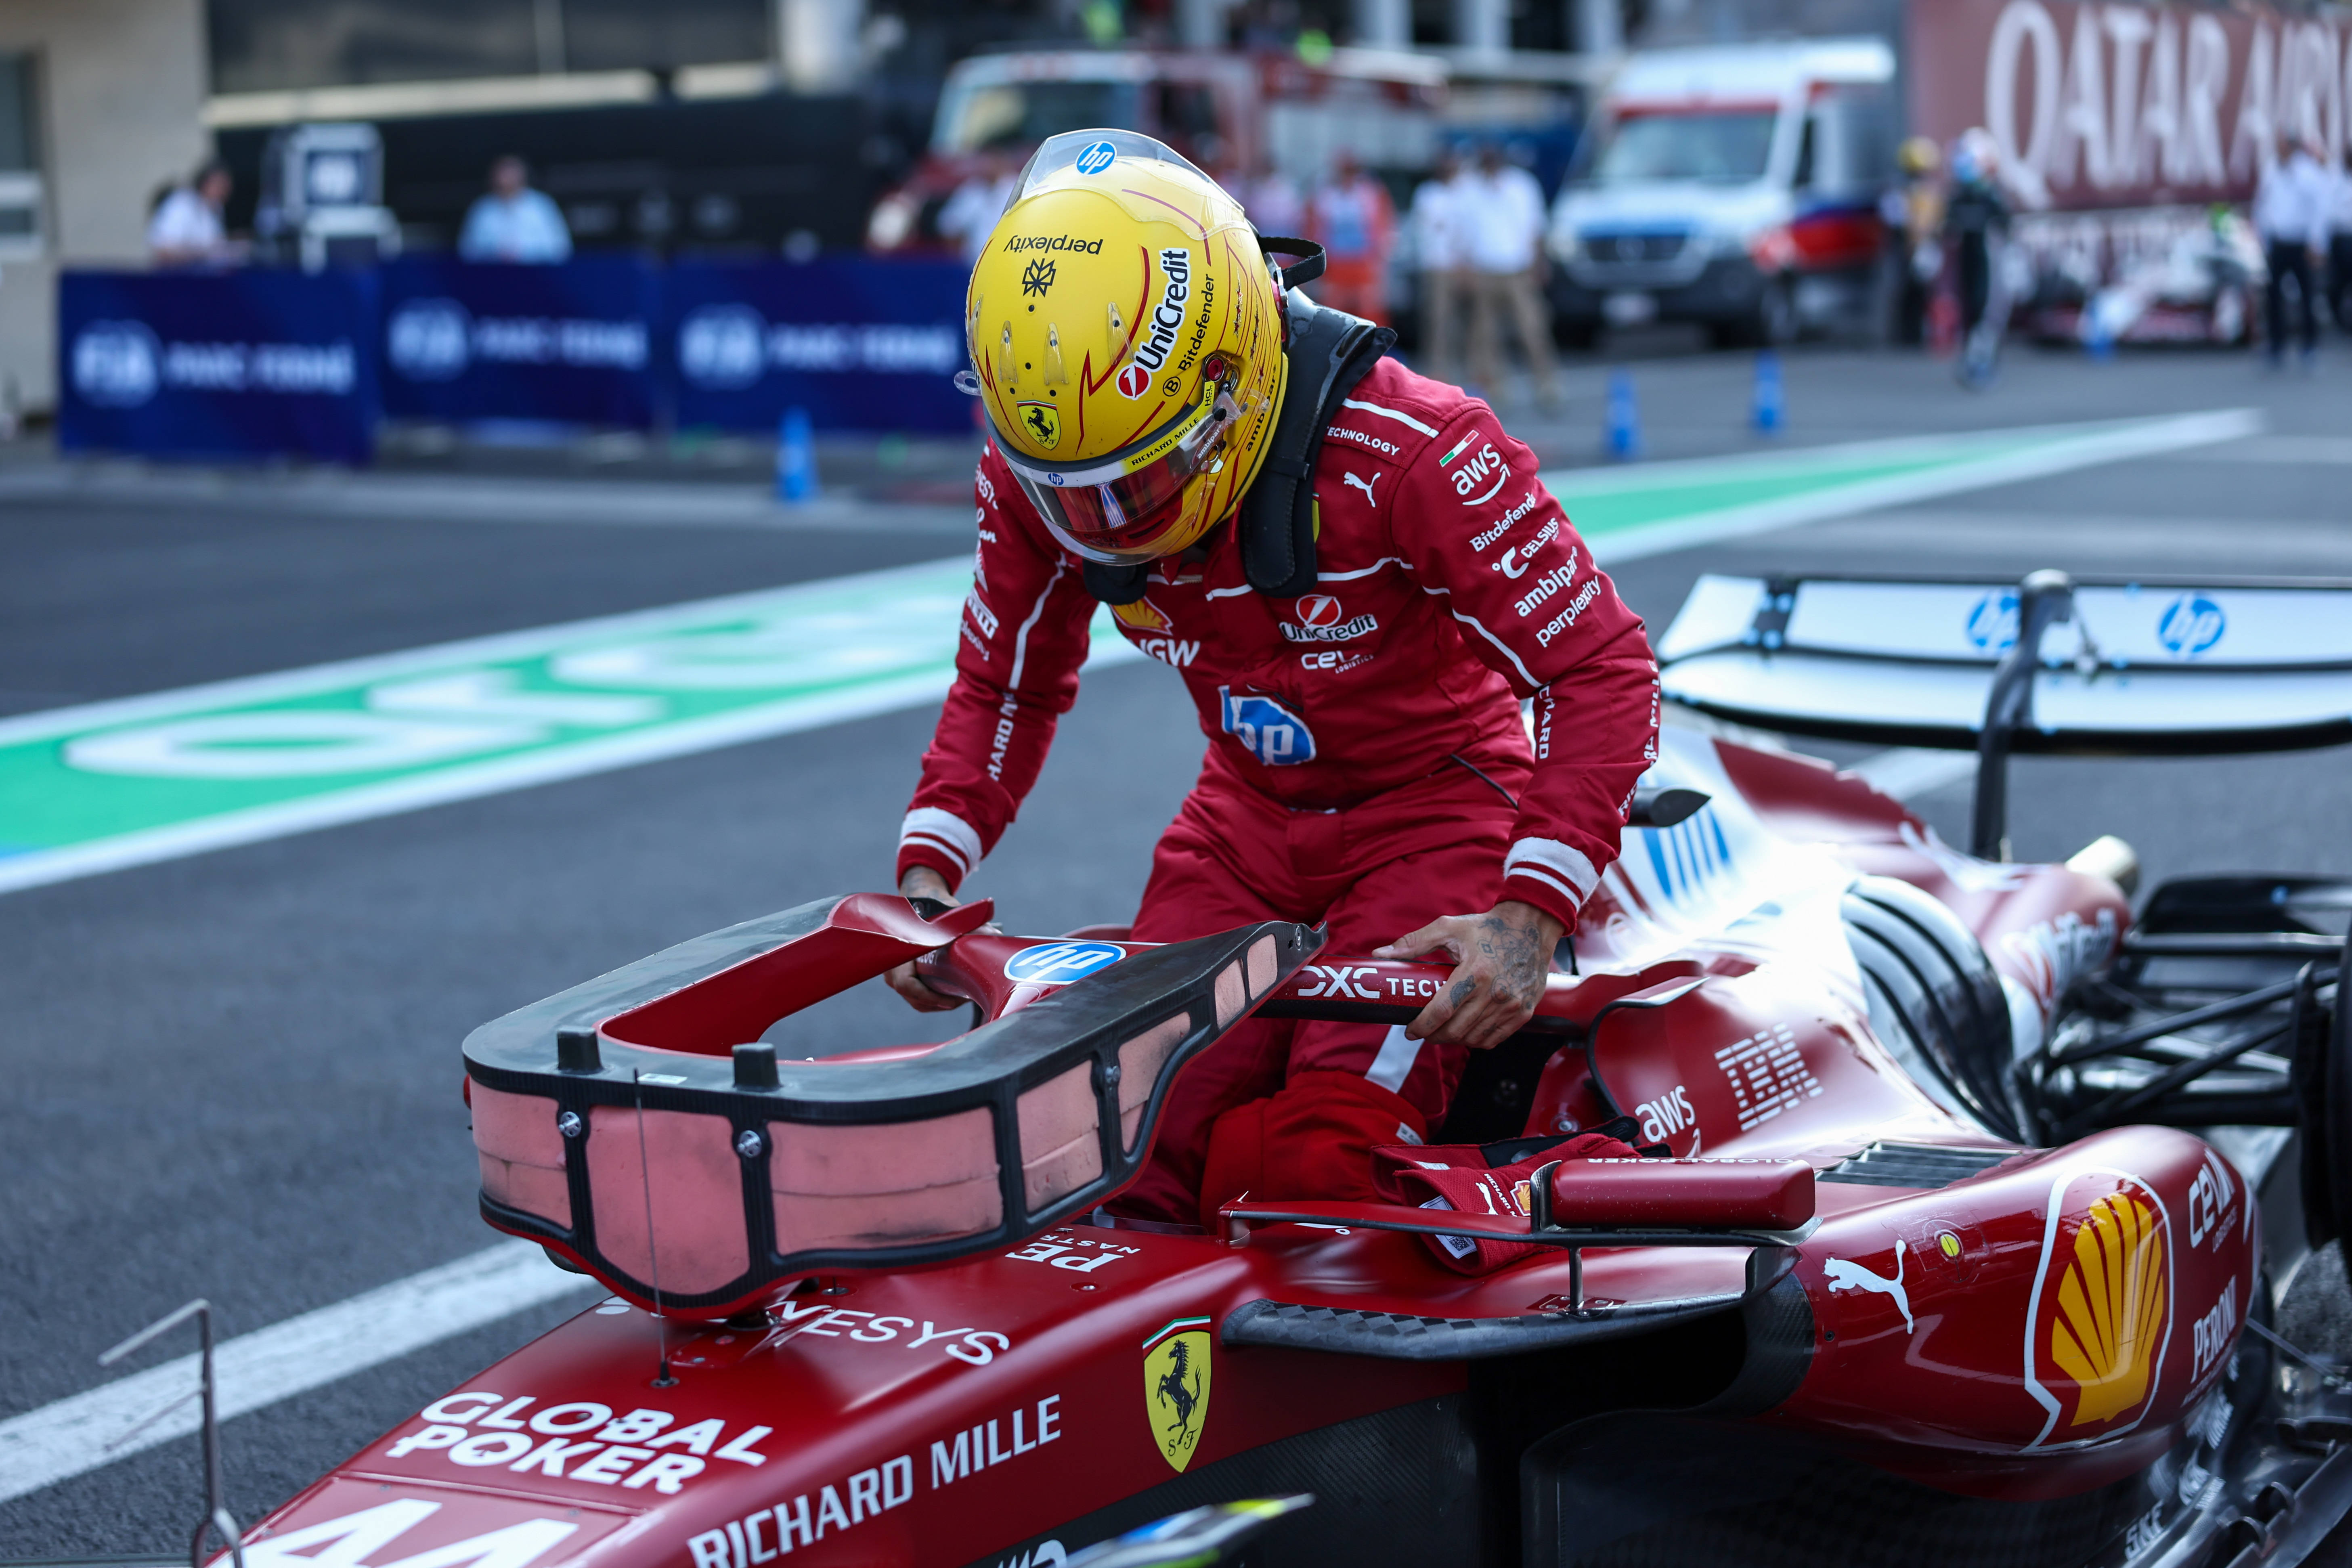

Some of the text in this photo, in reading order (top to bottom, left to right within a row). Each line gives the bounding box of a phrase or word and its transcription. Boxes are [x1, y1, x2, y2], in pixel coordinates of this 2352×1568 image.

[1985, 0, 2227, 209] QATAR
[1079, 143, 1116, 175] hp
[1004, 234, 1104, 255] perplexity
[1135, 248, 1189, 371] UniCredit
[1178, 273, 1214, 371] Bitdefender
[1132, 416, 1199, 466] RICHARD MILLE
[1451, 443, 1501, 496] aws
[1050, 473, 1063, 485] hp
[1520, 517, 1559, 558] CELSIUS
[1280, 614, 1377, 641] UniCredit
[1536, 575, 1602, 648] perplexity
[2163, 590, 2223, 662] hp
[1334, 654, 1374, 674] LOGISTICS
[1015, 944, 1115, 983] hp
[1715, 1022, 1824, 1131] IBM
[1635, 1085, 1696, 1143] aws
[1484, 1172, 1511, 1210] RICHARD
[2190, 1275, 2237, 1385] PERONI
[421, 1391, 774, 1465] GLOBAL
[386, 1424, 705, 1494] POKER
[687, 1393, 1062, 1568] RICHARD MILLE
